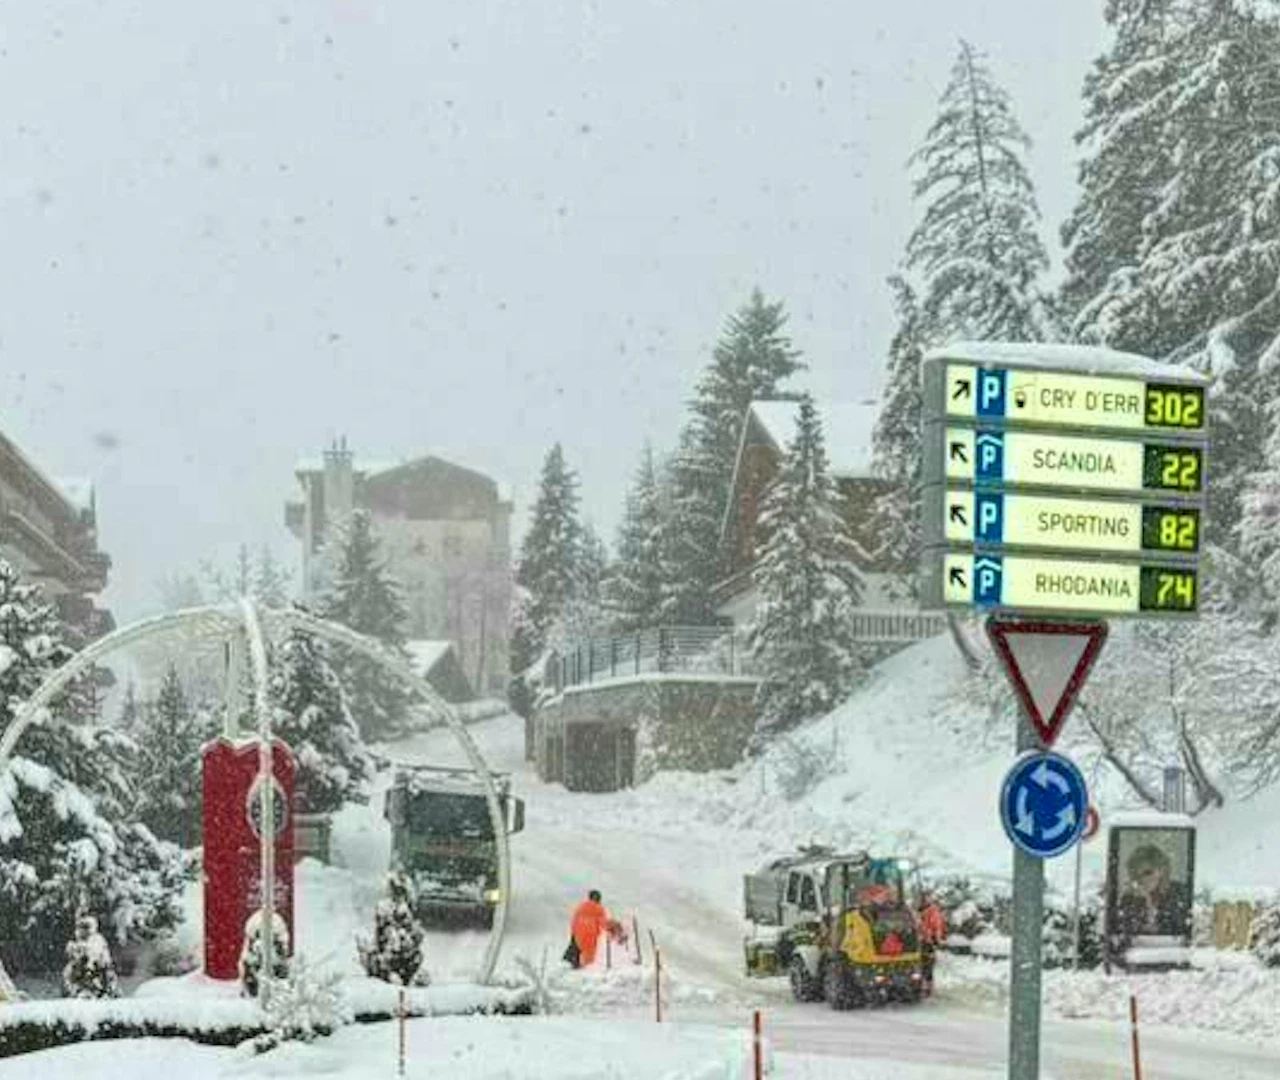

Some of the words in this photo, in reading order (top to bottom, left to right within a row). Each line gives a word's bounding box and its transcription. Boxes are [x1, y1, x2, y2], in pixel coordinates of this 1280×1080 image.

[982, 376, 999, 409] P
[1040, 387, 1077, 409] CRY
[1085, 390, 1140, 413] D'ERR
[1147, 394, 1199, 425] 302
[981, 444, 996, 472] P
[1033, 449, 1116, 473] SCANDIA
[1162, 454, 1198, 486] 22
[980, 502, 997, 534] P
[1038, 512, 1129, 537] SPORTING
[1159, 515, 1195, 546] 82
[980, 570, 994, 596] P
[1035, 574, 1132, 598] RHODANIA
[1157, 576, 1194, 606] 74
